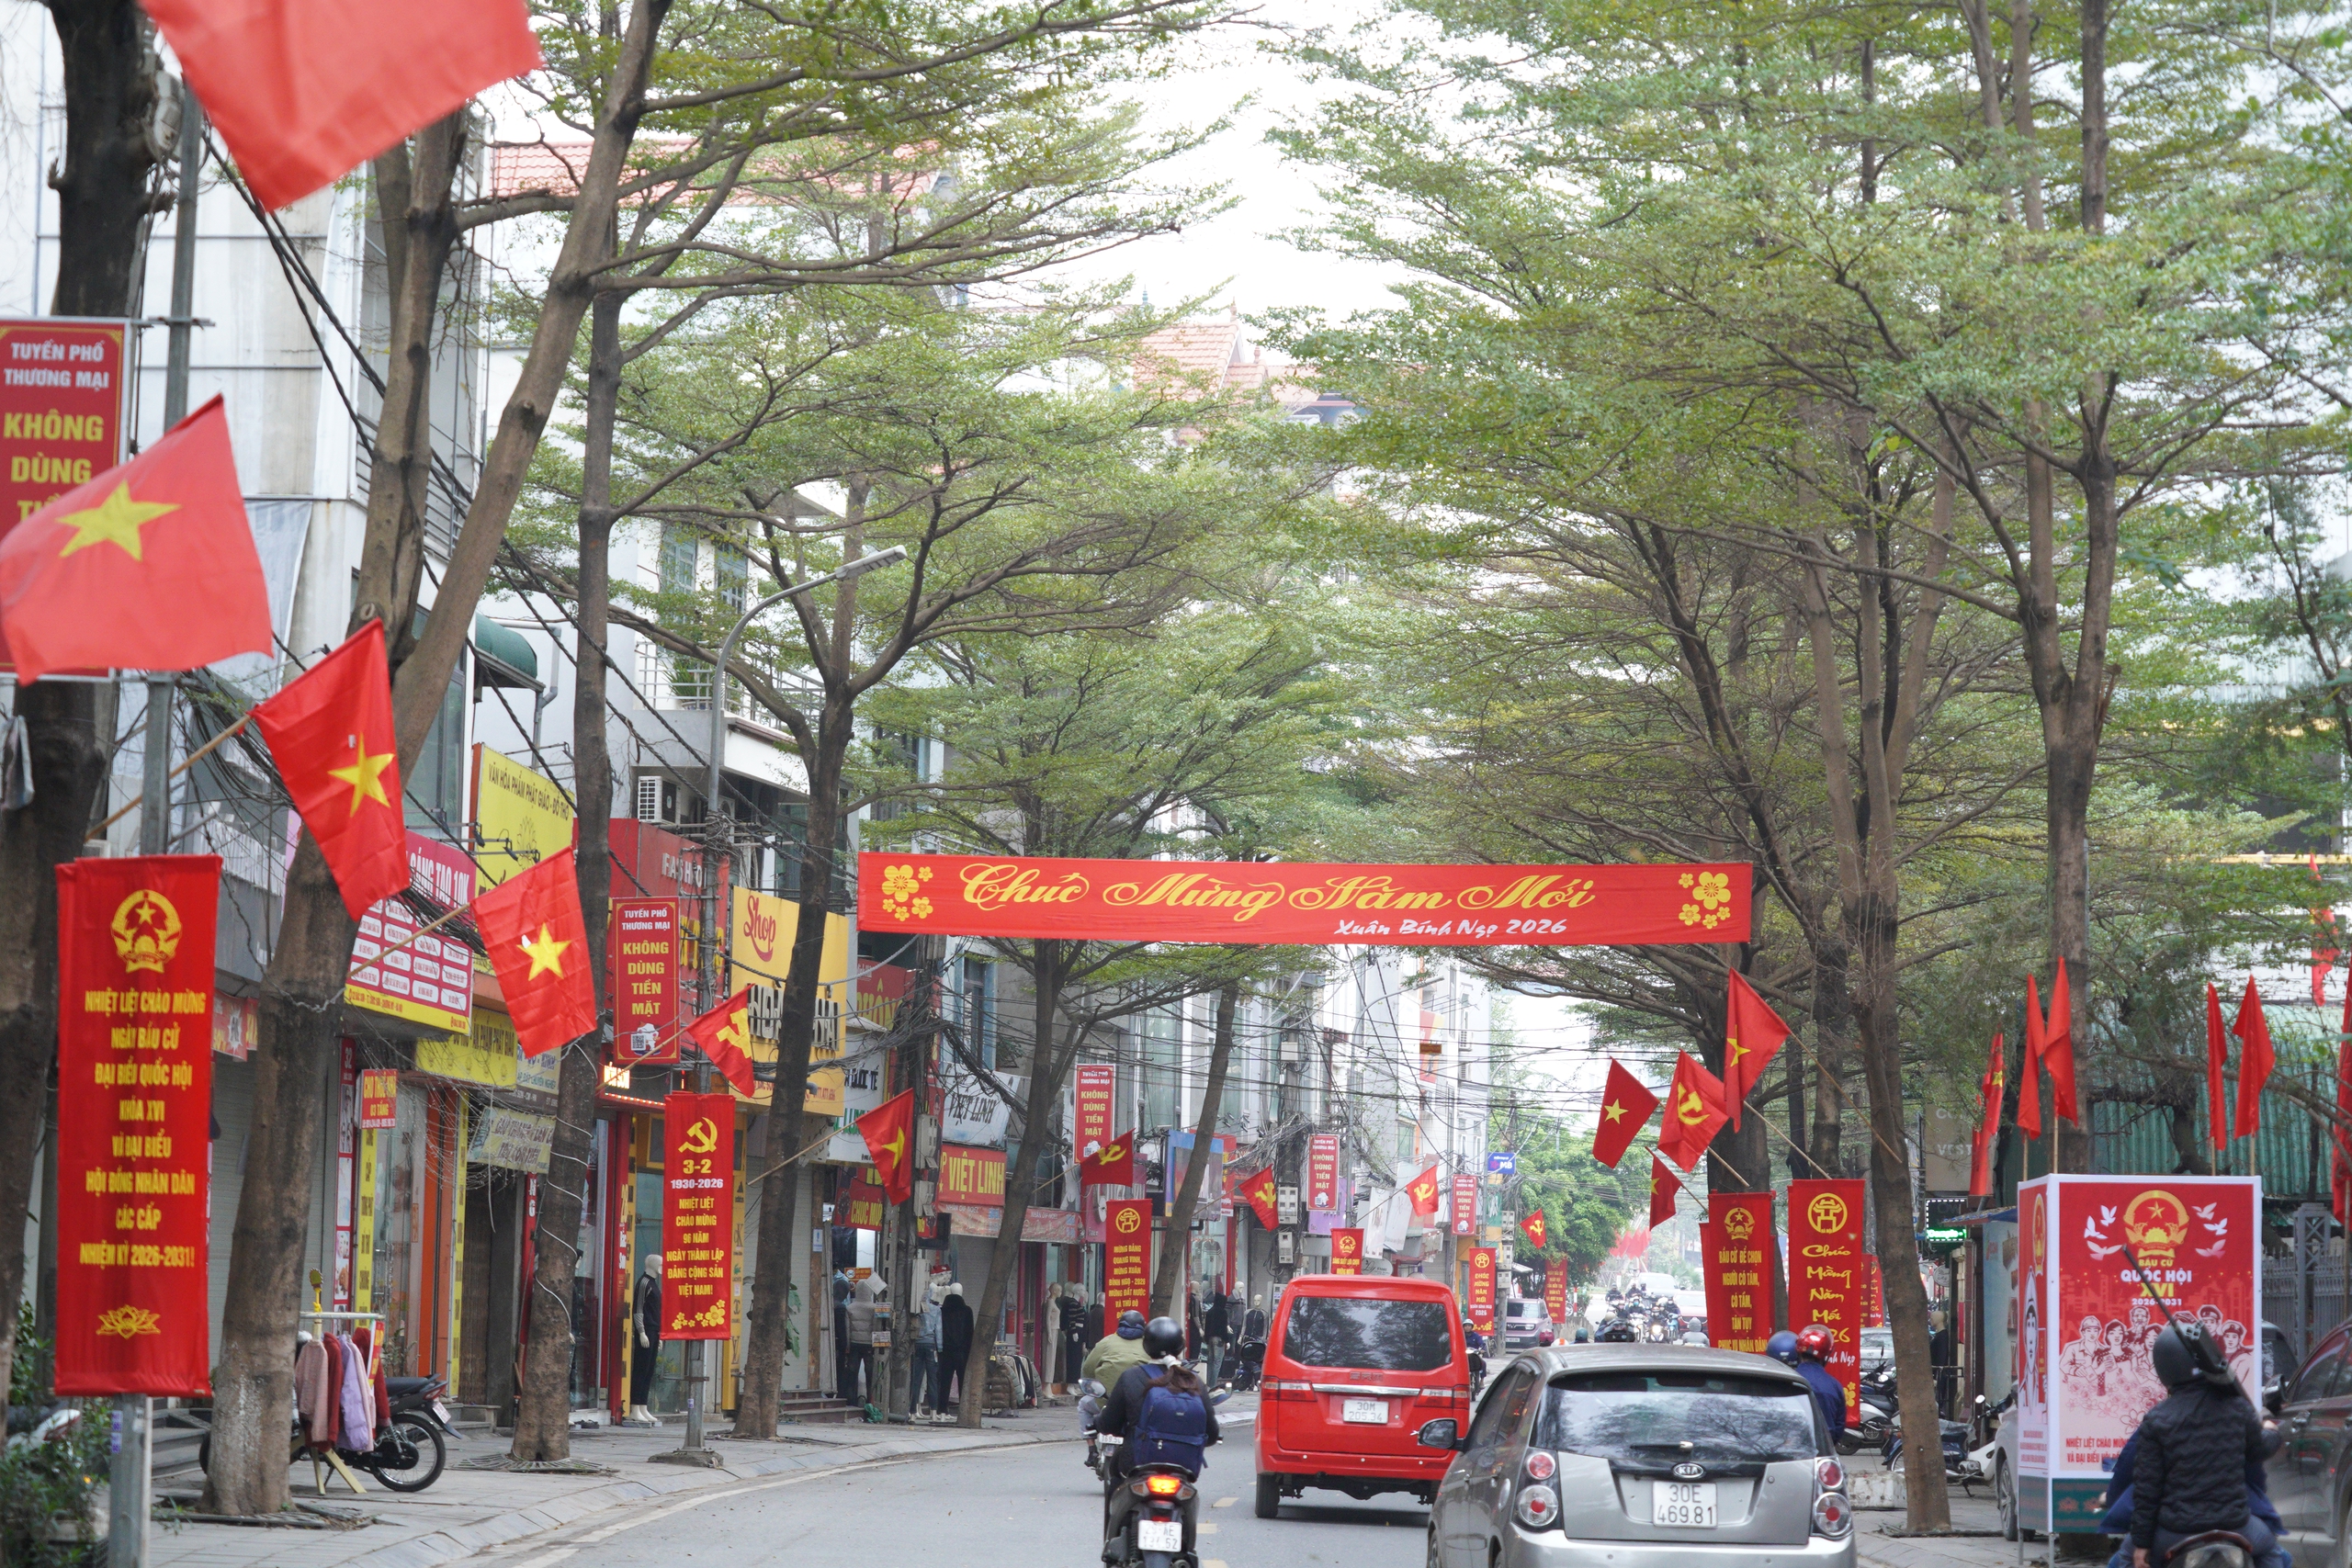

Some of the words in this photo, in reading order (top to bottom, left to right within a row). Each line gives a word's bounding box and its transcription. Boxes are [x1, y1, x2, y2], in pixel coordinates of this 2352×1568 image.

[11, 339, 64, 360] TUYẾN
[69, 340, 105, 362] PHỐ
[4, 367, 71, 387] THƯƠNG
[75, 370, 109, 392] MẠI
[3, 408, 104, 441] KHÔNG
[11, 452, 92, 484] DÙNG
[489, 761, 500, 785] VĂN
[511, 771, 526, 798] PHẨM
[526, 783, 537, 809] PHẬT
[537, 786, 550, 811] GIÁO
[959, 863, 1090, 911] Chúc
[1102, 872, 1285, 922] Mừng
[1288, 875, 1453, 910] Năm
[1457, 874, 1596, 910] Mới
[624, 908, 649, 919] TUYẾN
[650, 907, 668, 918] PHỐ
[622, 921, 652, 931] THƯƠNG
[655, 921, 671, 931] MẠI
[743, 895, 776, 962] Shop
[1334, 919, 1390, 936] Xuân
[1399, 919, 1453, 936] Bính
[1456, 919, 1499, 940] Ngọ
[1505, 919, 1567, 935] 2026
[623, 940, 670, 954] KHÔNG
[628, 960, 665, 975] DÙNG
[631, 978, 662, 995] TIỀN
[85, 987, 119, 1018] NHIỆT
[119, 987, 139, 1018] LIỆT
[141, 987, 171, 1013] CHÀO
[172, 987, 207, 1014] MỪNG
[631, 1000, 661, 1018] MẶT
[162, 1021, 180, 1050] CỬ
[139, 1056, 170, 1088] QUỐC
[172, 1060, 193, 1091] HỘI
[1080, 1089, 1109, 1099] KHÔNG
[146, 1100, 165, 1122] XVI
[1083, 1102, 1105, 1111] DÙNG
[1085, 1113, 1103, 1123] TIỀN
[1085, 1126, 1102, 1137] MẶT
[1312, 1153, 1335, 1161] KHÔNG
[1937, 1144, 1973, 1156] VEST
[683, 1158, 712, 1175] 3-2
[1499, 1161, 1513, 1169] MB
[85, 1167, 107, 1198] HỘI
[135, 1168, 169, 1194] NHÂN
[171, 1168, 196, 1195] DÂN
[948, 1151, 976, 1200] VIỆT
[977, 1160, 1005, 1195] LINH
[671, 1179, 724, 1190] 1930-2026
[679, 1196, 698, 1212] NHIỆT
[700, 1196, 714, 1211] LIỆT
[851, 1196, 869, 1225] CHÚC
[116, 1203, 135, 1230] CÁC
[136, 1201, 162, 1231] CẤP
[676, 1213, 695, 1226] CHÀO
[695, 1213, 717, 1226] MỪNG
[683, 1234, 692, 1244] 96
[693, 1231, 709, 1243] NĂM
[666, 1248, 686, 1261] NGÀY
[687, 1248, 710, 1261] THÀNH
[711, 1247, 724, 1263] LẬP
[1747, 1250, 1762, 1266] CHỌN
[1802, 1244, 1851, 1258] Chúc
[2138, 1258, 2158, 1267] BẦU
[2160, 1257, 2174, 1267] CỬ
[667, 1265, 687, 1279] ĐẢNG
[688, 1266, 707, 1280] CỘNG
[708, 1264, 724, 1278] SẢN
[1723, 1269, 1738, 1286] NGƯỜI
[1738, 1270, 1747, 1285] CÓ
[1806, 1265, 1852, 1289] Mừng
[2120, 1266, 2161, 1282] QUỐC
[2165, 1268, 2192, 1286] HỘI
[678, 1282, 693, 1298] VIỆT
[694, 1284, 713, 1295] NAM!
[1810, 1287, 1844, 1303] Năm
[2140, 1282, 2174, 1297] XVI
[1731, 1292, 1738, 1308] CÓ
[1732, 1314, 1741, 1333] TẬN
[1839, 1350, 1856, 1367] Ngọ
[1357, 1402, 1375, 1411] 30M
[1349, 1411, 1383, 1422] 205.34
[2066, 1436, 2082, 1450] NHIỆT
[2083, 1436, 2095, 1450] LIỆT
[2097, 1436, 2111, 1448] CHÀO
[2067, 1450, 2075, 1462] VÀ
[1679, 1466, 1698, 1474] KIA
[1669, 1483, 1702, 1504] 30E
[1657, 1505, 1713, 1525] 469.81
